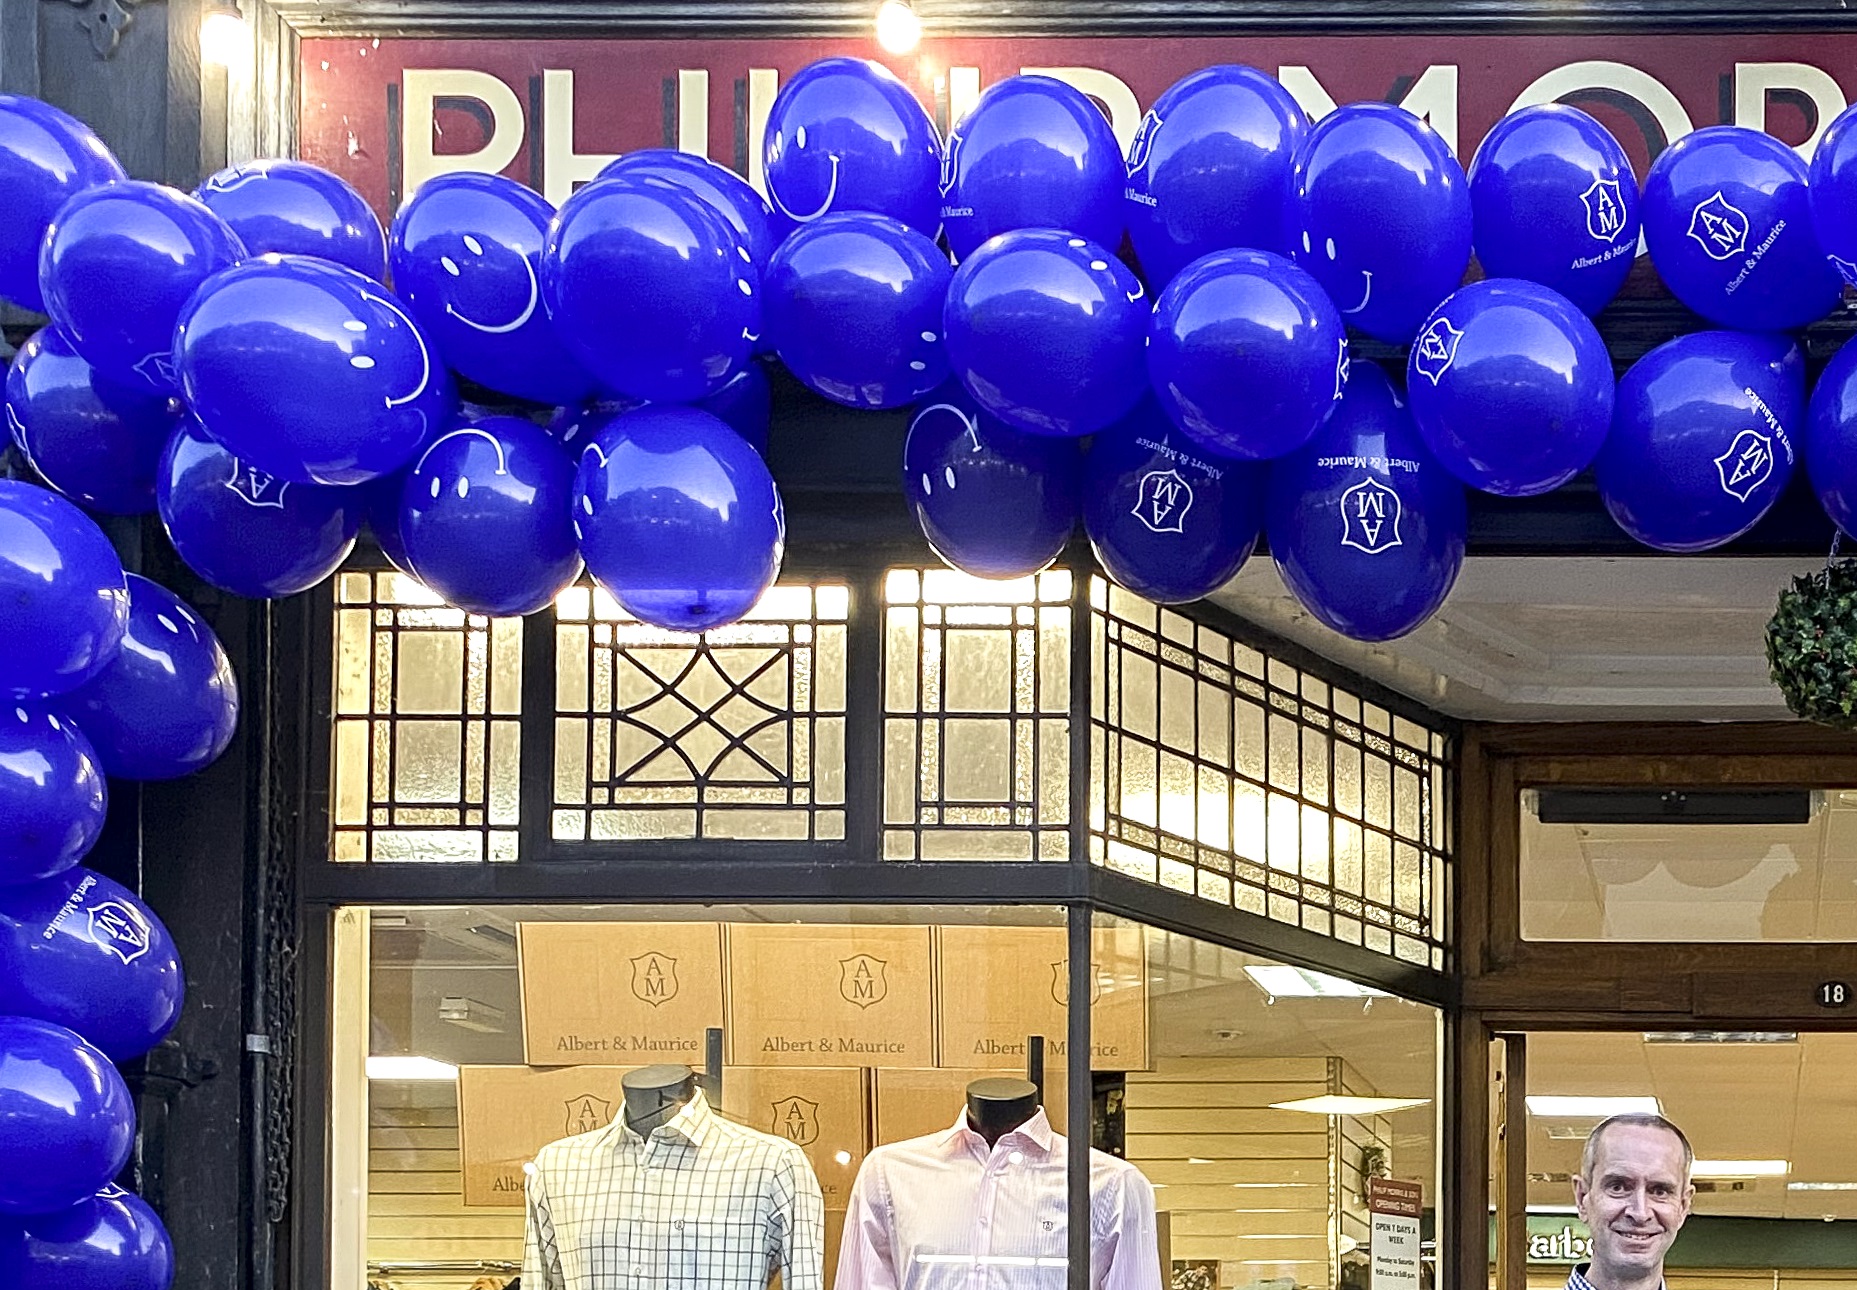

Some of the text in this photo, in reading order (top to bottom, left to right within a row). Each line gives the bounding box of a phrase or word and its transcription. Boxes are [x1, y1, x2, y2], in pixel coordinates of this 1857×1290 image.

[402, 66, 1146, 200] PHIP
[1725, 219, 1787, 296] Albert & Maurice
[1744, 387, 1778, 430] Maurice
[1317, 456, 1421, 473] Albert & Maurice
[43, 900, 78, 941] Maurice
[1823, 984, 1844, 1003] 18
[556, 1034, 699, 1052] Albert & Maurice
[762, 1037, 907, 1054] Albert & Maurice
[973, 1040, 1119, 1057] Albert Mice
[491, 1175, 527, 1192] Albe
[1375, 1199, 1416, 1213] OPENING TIMES
[1375, 1222, 1417, 1235] OPEN 7 DAYS A
[1388, 1235, 1404, 1245] WEEK
